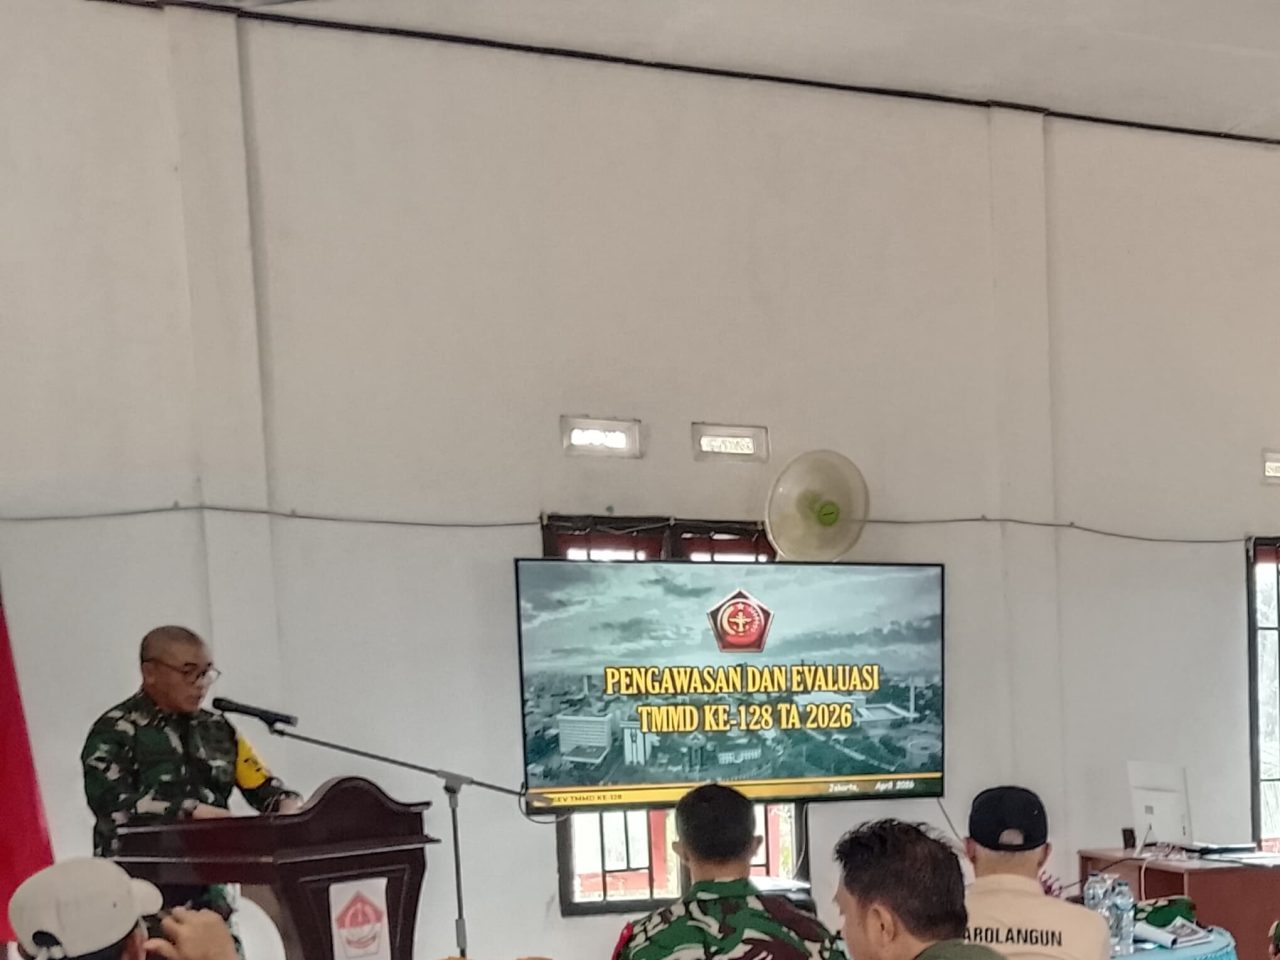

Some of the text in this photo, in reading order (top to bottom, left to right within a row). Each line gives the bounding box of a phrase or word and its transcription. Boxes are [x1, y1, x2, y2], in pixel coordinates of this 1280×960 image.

[604, 664, 880, 695] PENGAWASAN DAN EVALUASI
[637, 703, 853, 733] TMMD KE-128 TA 2026
